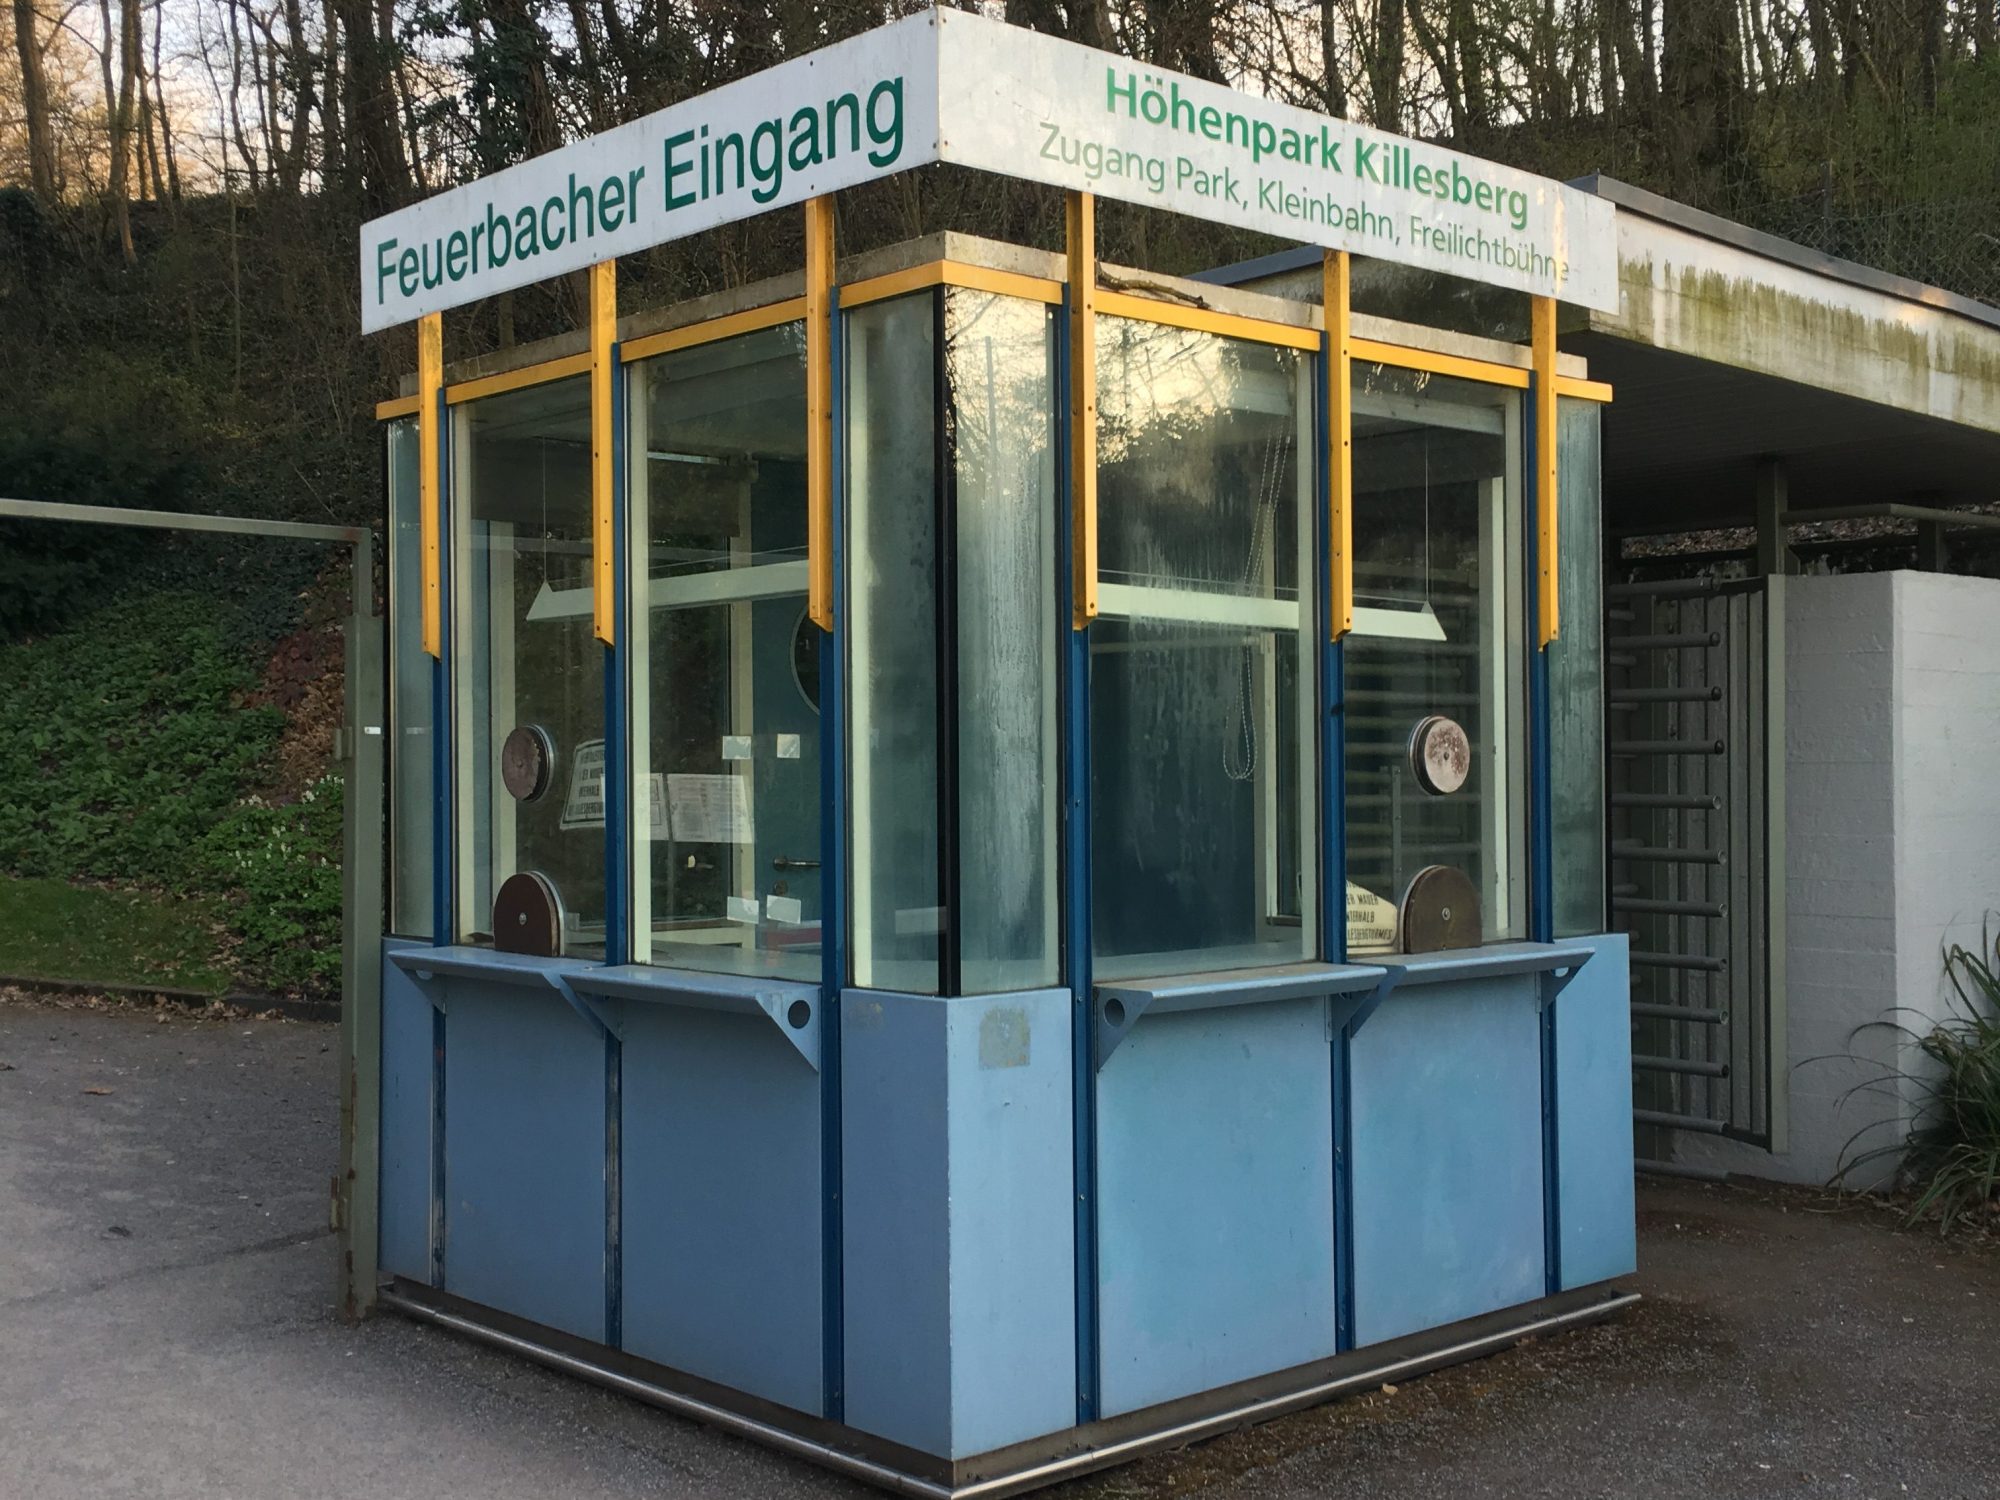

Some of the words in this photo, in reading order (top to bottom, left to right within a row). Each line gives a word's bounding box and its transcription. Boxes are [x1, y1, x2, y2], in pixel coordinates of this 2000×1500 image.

[377, 165, 645, 305] Feuerbacher
[664, 76, 904, 213] Eingang
[1039, 122, 1165, 193] Zugang
[1177, 156, 1248, 211] Park,
[1259, 177, 1401, 246] Kleinbahn,
[1410, 215, 1570, 282] Freilichtbühne
[1106, 65, 1342, 173] Höhenpark
[1355, 137, 1529, 230] Killesberg
